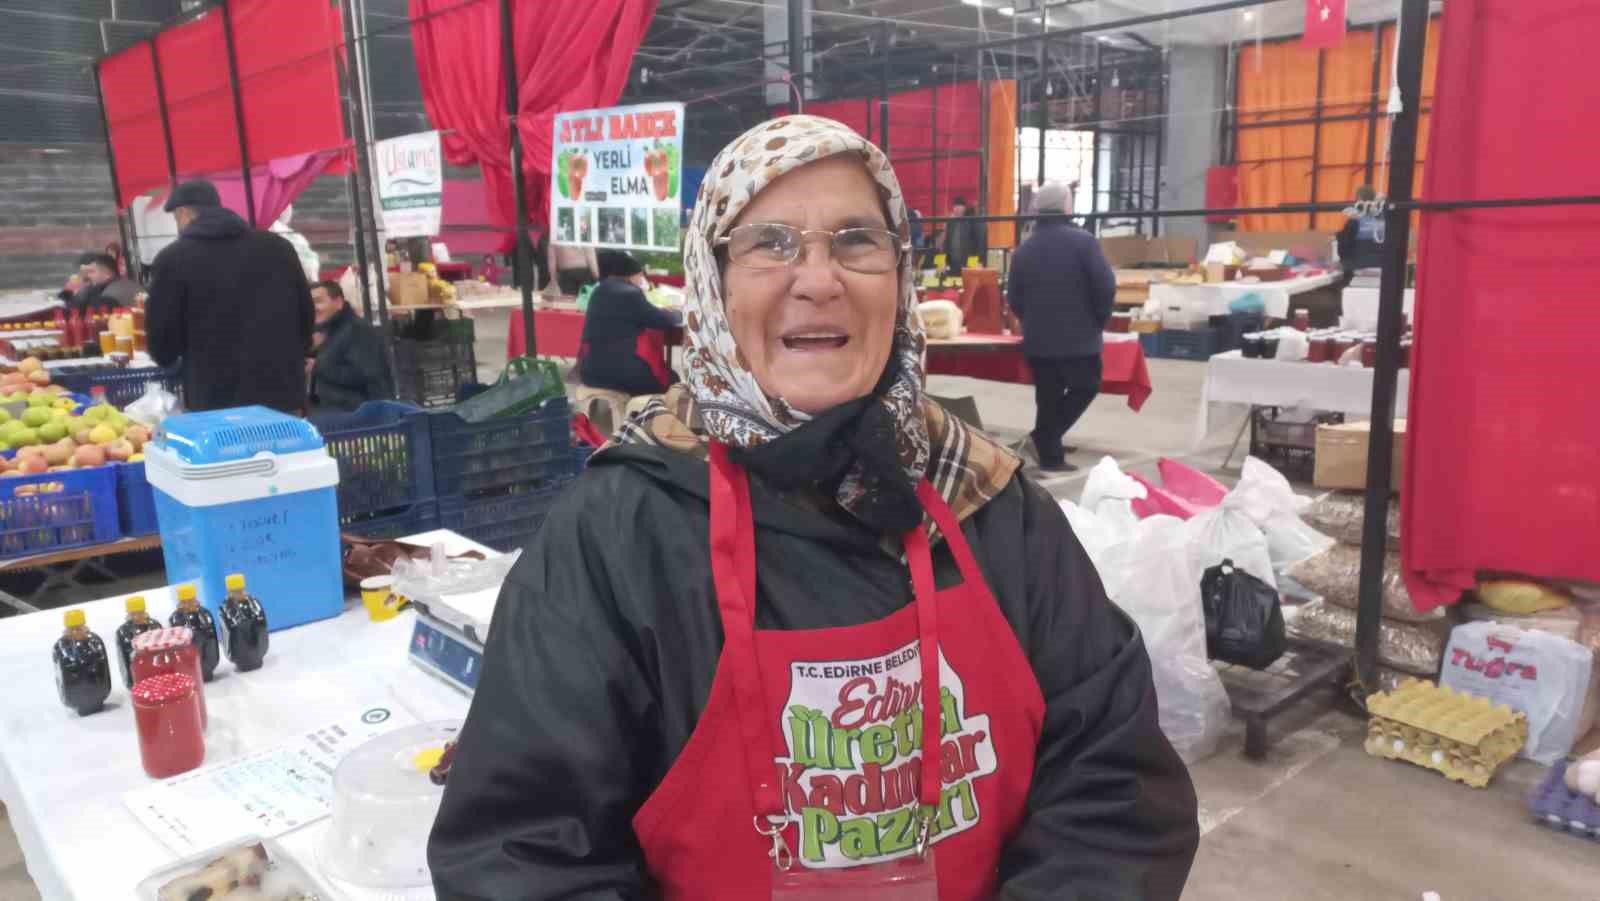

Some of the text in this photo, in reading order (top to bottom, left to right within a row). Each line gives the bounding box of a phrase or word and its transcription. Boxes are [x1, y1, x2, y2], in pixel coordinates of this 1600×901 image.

[593, 143, 632, 170] YERLİ
[610, 176, 649, 195] ELMA
[774, 730, 986, 818] Kadınar
